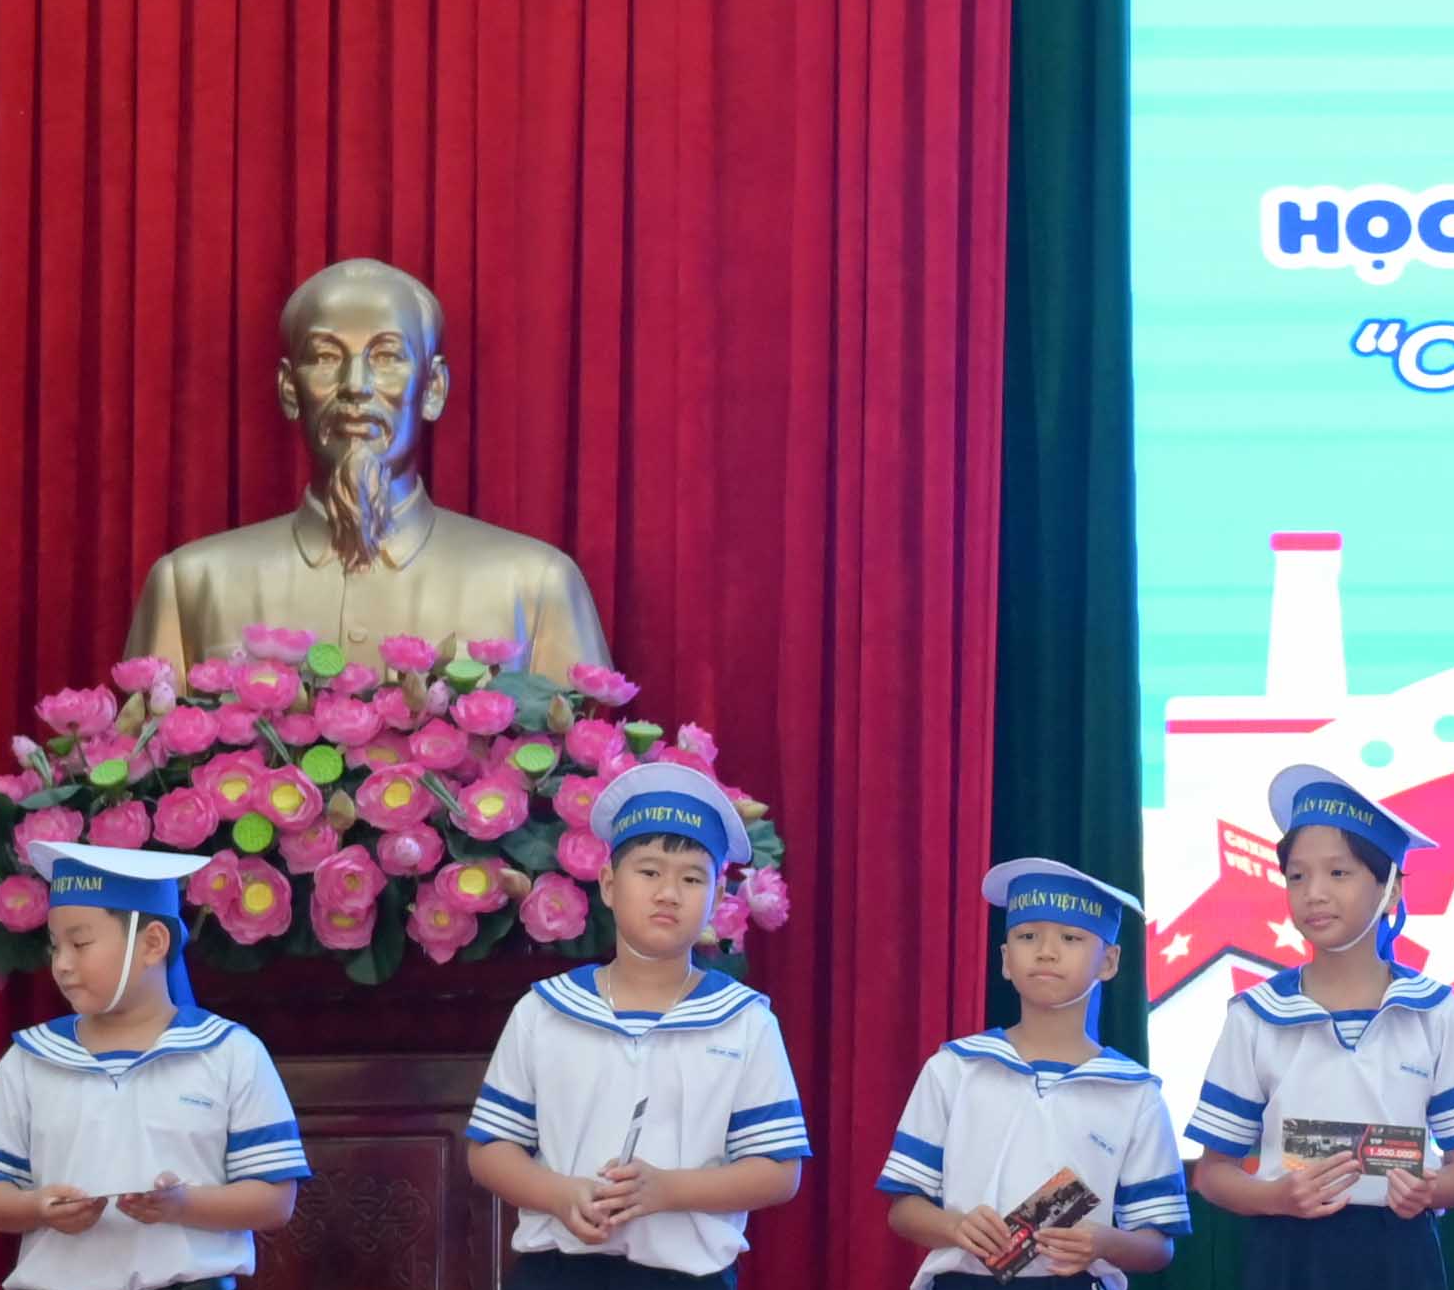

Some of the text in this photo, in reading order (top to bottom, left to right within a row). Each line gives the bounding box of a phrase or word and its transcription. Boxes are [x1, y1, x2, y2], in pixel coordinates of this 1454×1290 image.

[645, 806, 673, 822] VIỆT
[675, 809, 702, 829] NAM
[75, 876, 103, 891] NAM
[1049, 892, 1079, 913] VIỆT
[1080, 899, 1103, 918] NAM
